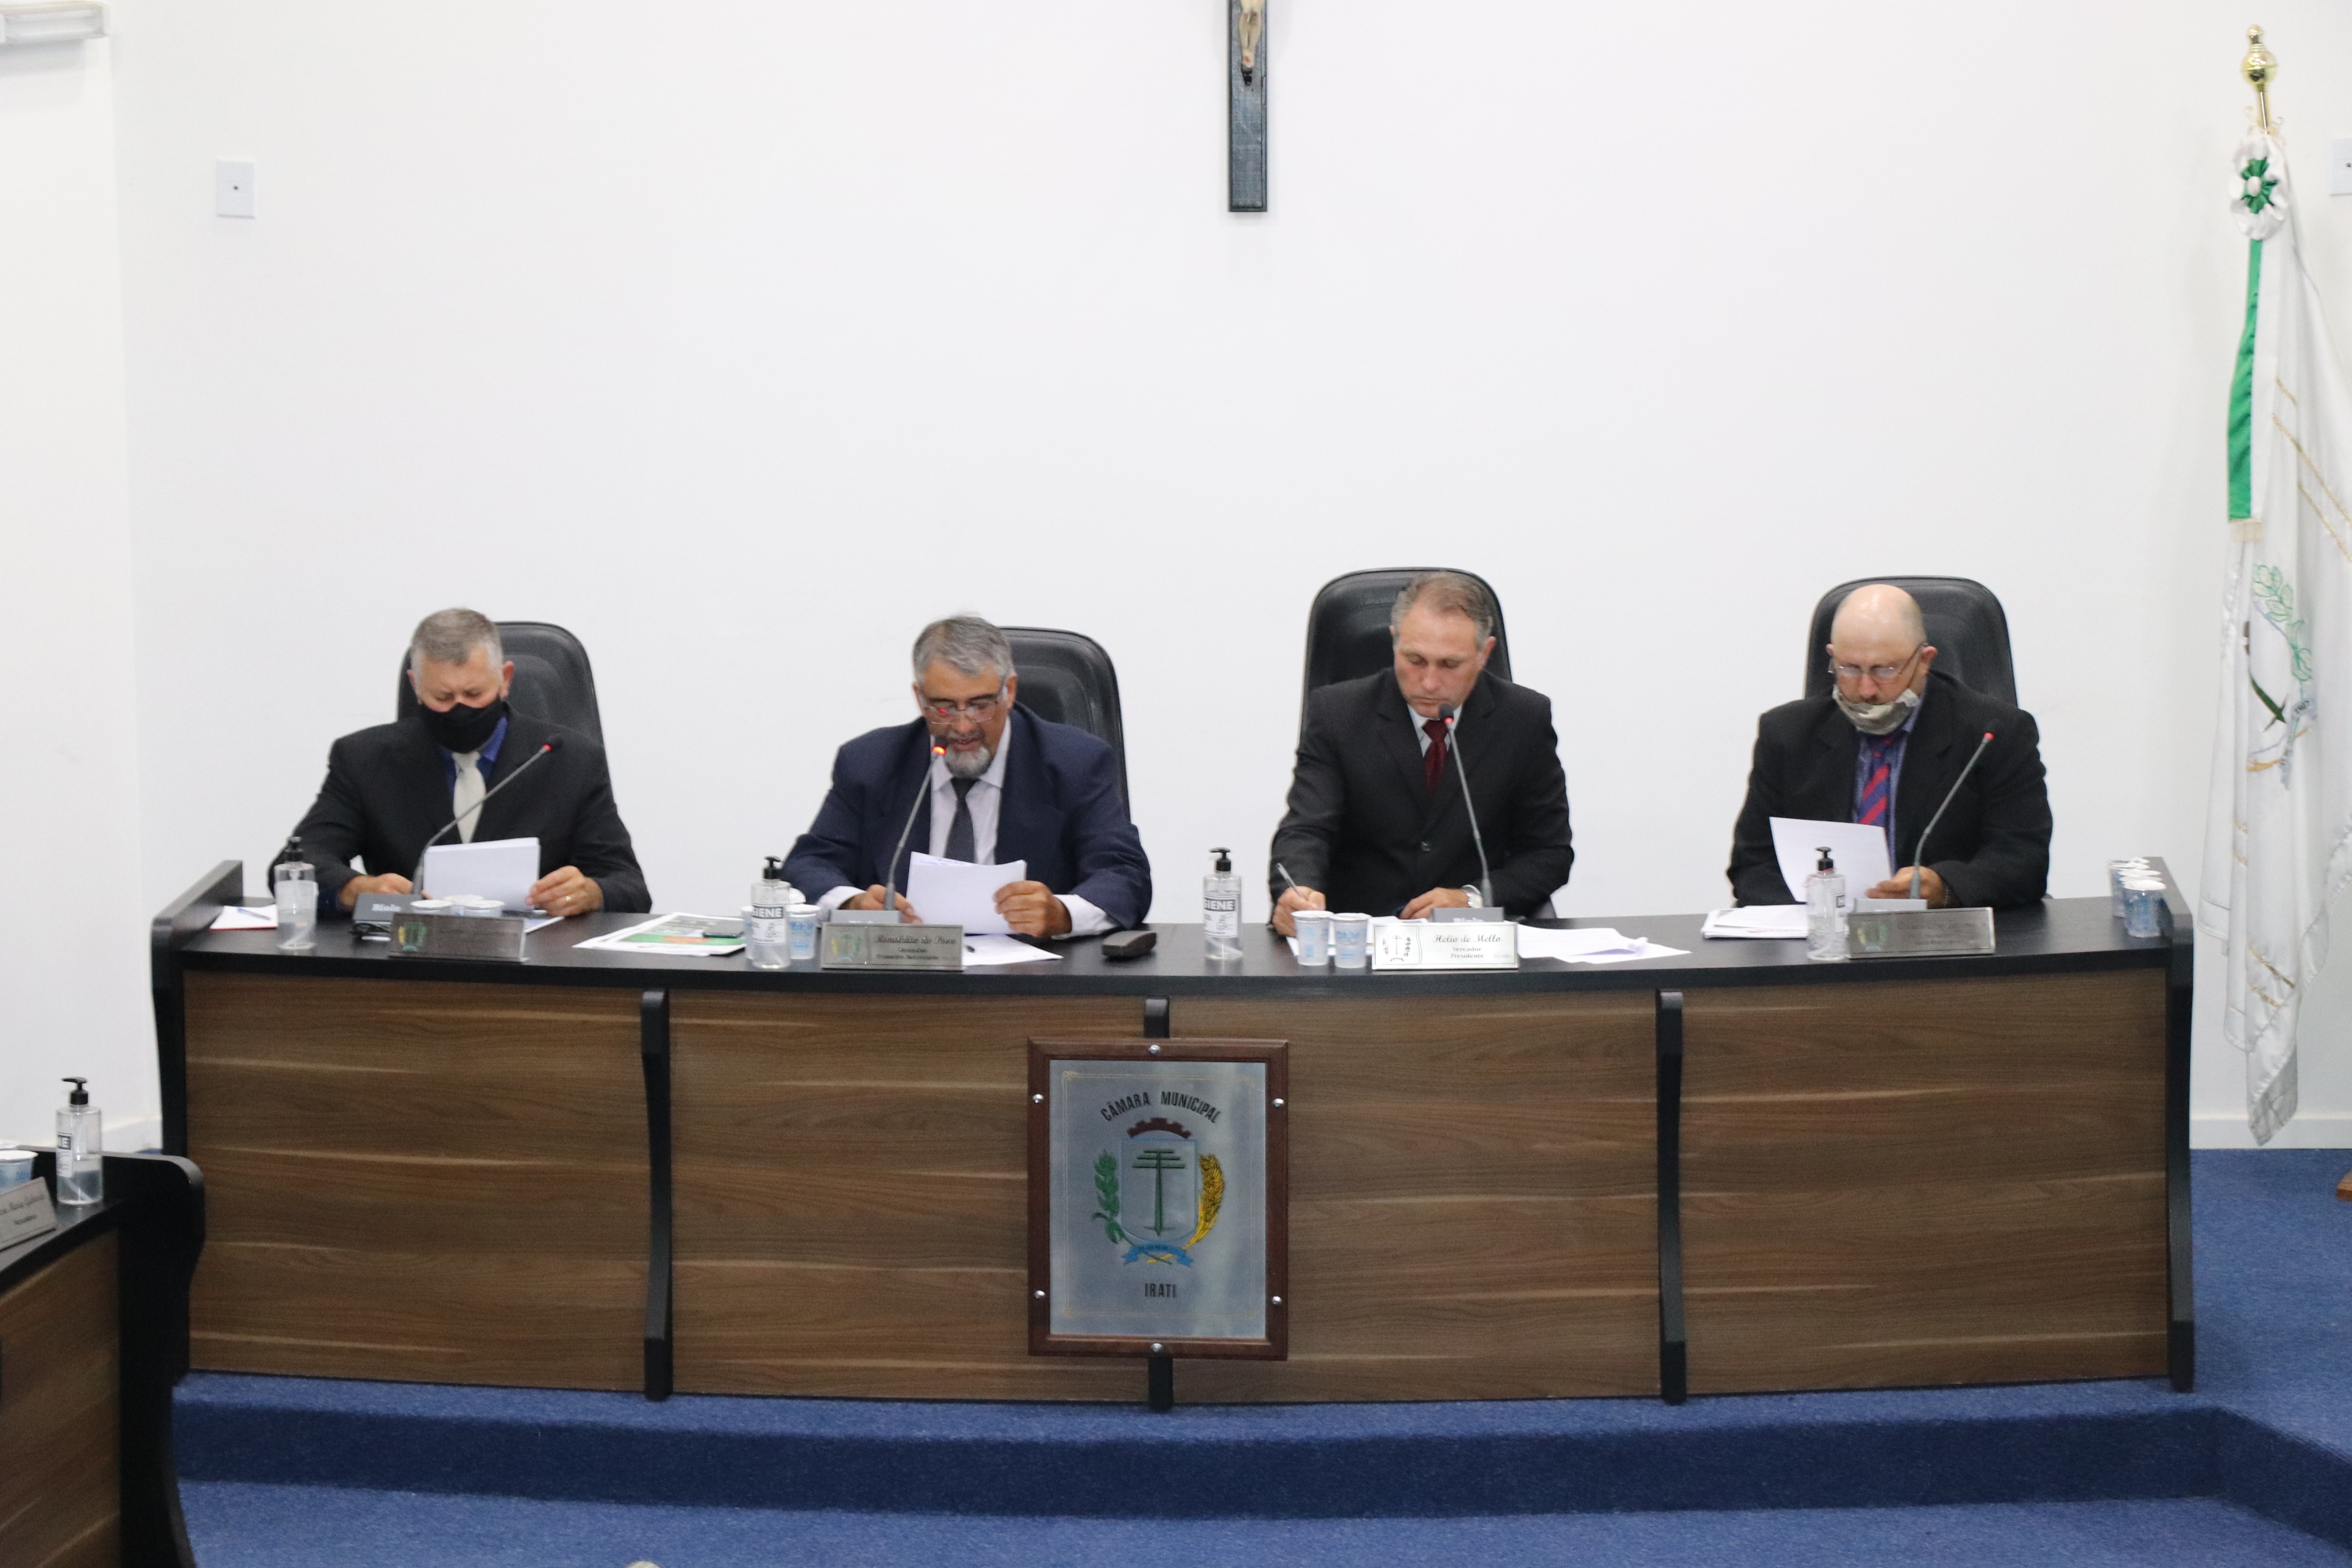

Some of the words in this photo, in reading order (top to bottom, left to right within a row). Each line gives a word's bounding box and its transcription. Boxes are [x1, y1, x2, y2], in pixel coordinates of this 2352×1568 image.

[1461, 934, 1471, 943] de
[1474, 934, 1502, 943] Mello
[1100, 1092, 1151, 1121] CÂMARA
[1160, 1091, 1221, 1123] MUNICIPAL
[1144, 1283, 1177, 1298] IRATI
